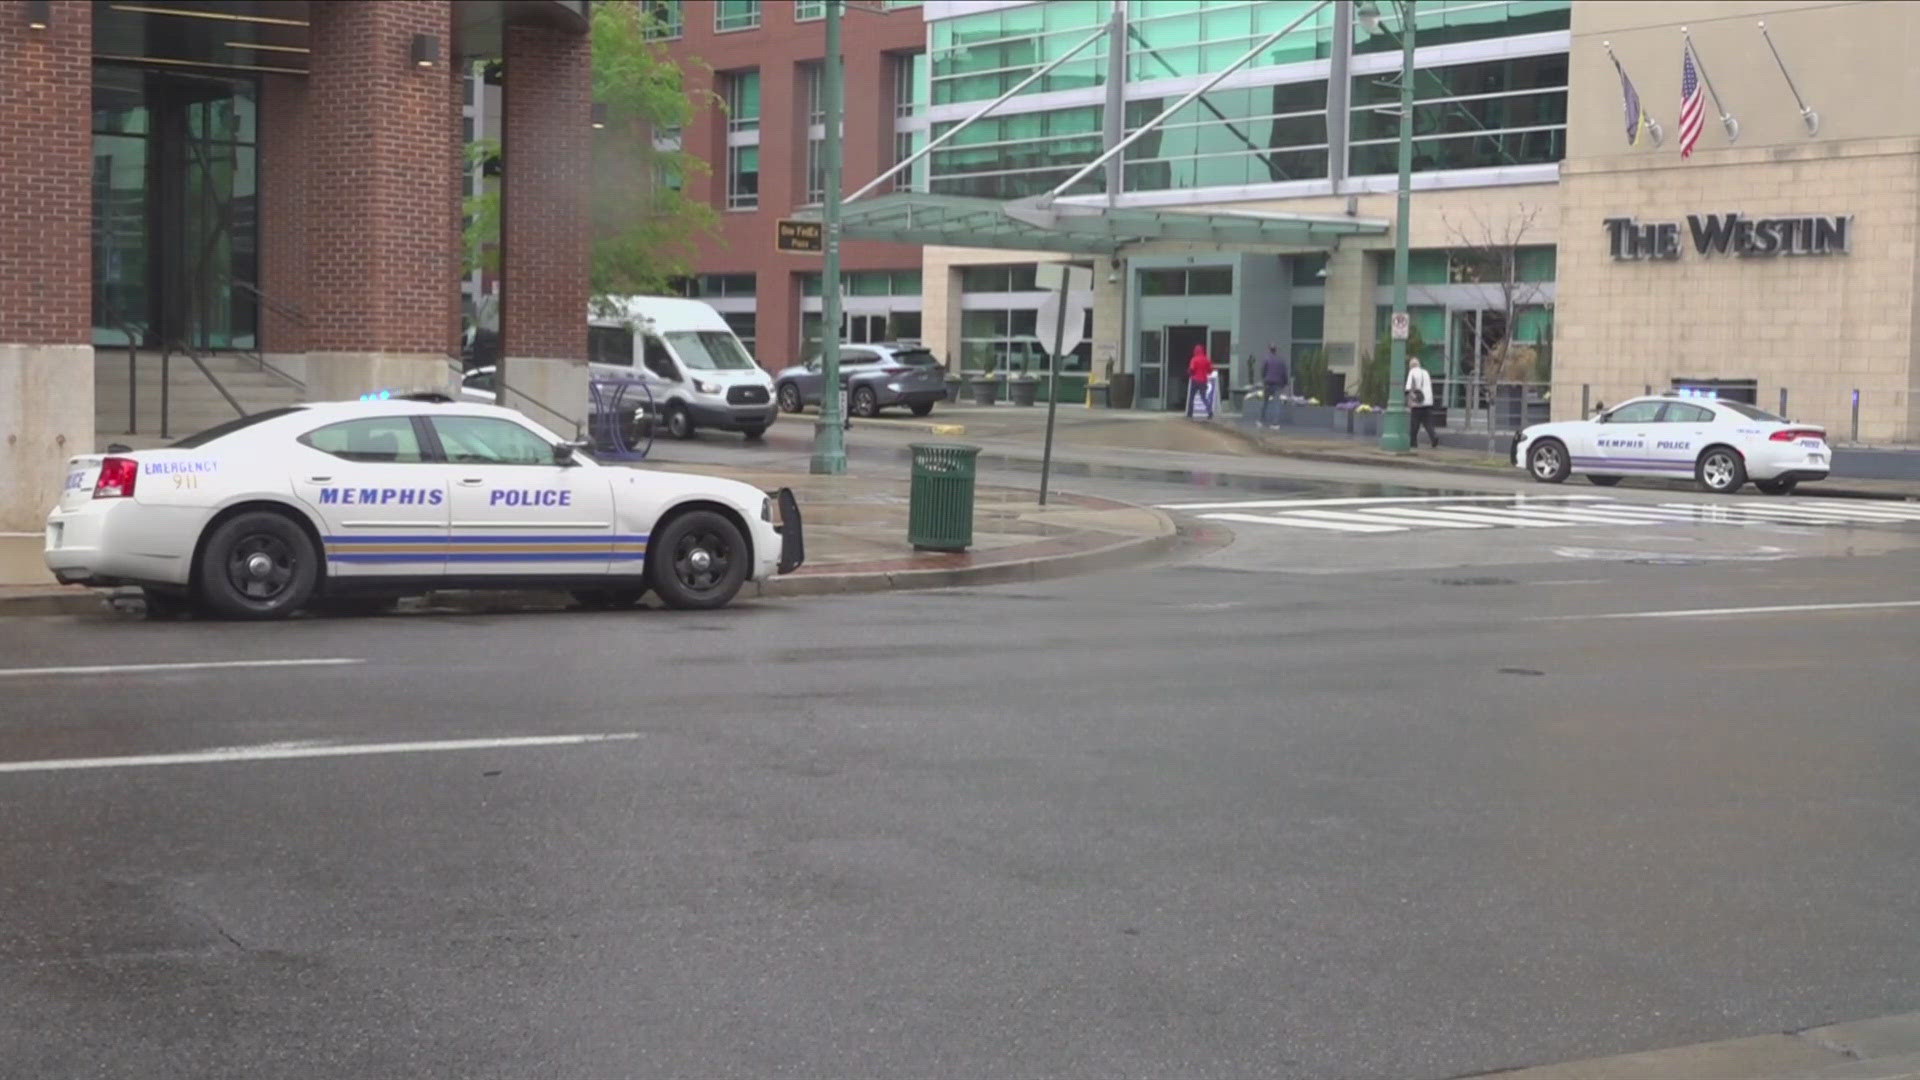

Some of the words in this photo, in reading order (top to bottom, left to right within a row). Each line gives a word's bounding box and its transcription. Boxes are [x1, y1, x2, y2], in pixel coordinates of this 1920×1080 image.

[1597, 439, 1644, 449] MEMPHIS
[1656, 441, 1690, 450] POLICE
[144, 460, 218, 475] EMERGENCY
[172, 475, 198, 489] 911
[319, 488, 444, 506] MEMPHIS
[489, 489, 572, 507] POLICE
